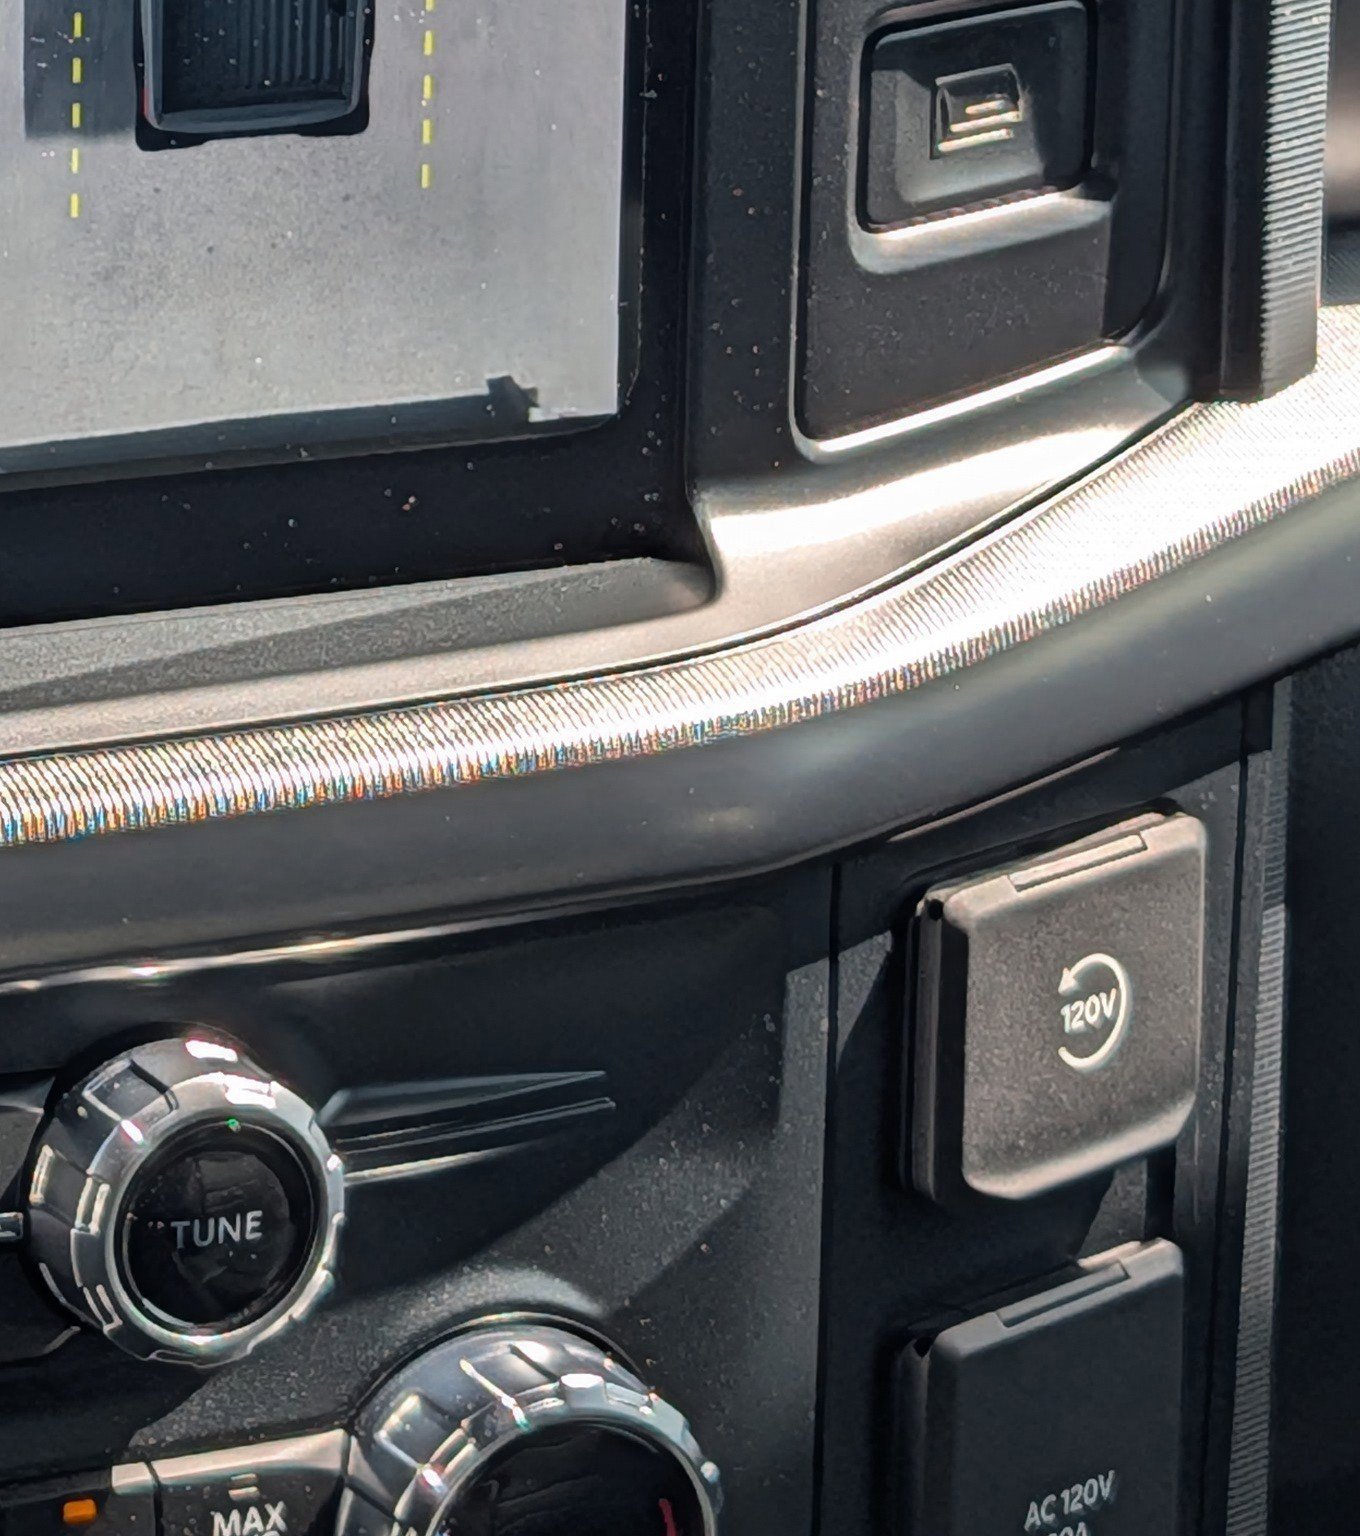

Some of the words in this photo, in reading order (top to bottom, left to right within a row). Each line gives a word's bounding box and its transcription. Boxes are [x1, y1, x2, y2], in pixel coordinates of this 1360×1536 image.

[1060, 987, 1118, 1034] 120V
[170, 1209, 264, 1249] TUNE
[210, 1500, 288, 1536] MAX
[1023, 1493, 1057, 1532] AC
[1060, 1469, 1116, 1515] 120V
